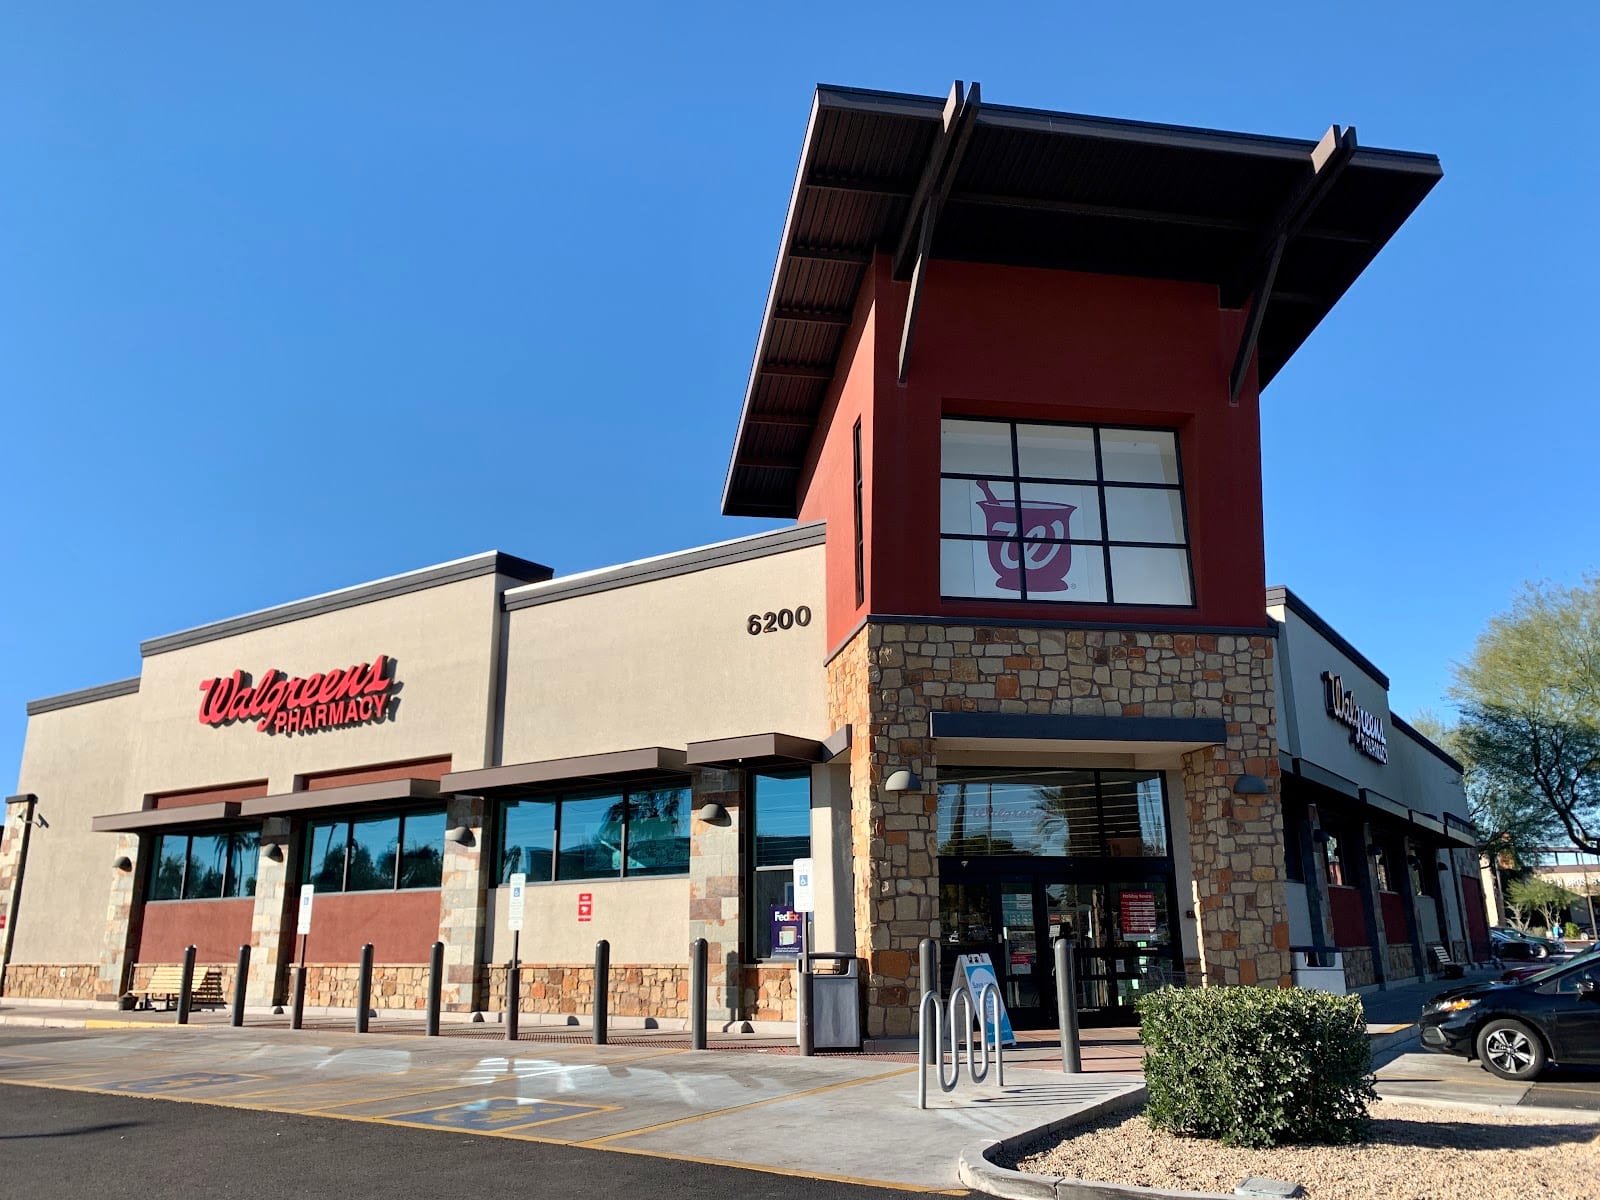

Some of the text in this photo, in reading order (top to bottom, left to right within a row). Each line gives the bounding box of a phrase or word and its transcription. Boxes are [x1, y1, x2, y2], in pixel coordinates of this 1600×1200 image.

[747, 605, 812, 635] 6200
[199, 655, 391, 732] Walgreens
[1322, 670, 1387, 745] Walgreens
[275, 694, 387, 733] PHARMACY
[774, 910, 800, 922] FedEx
